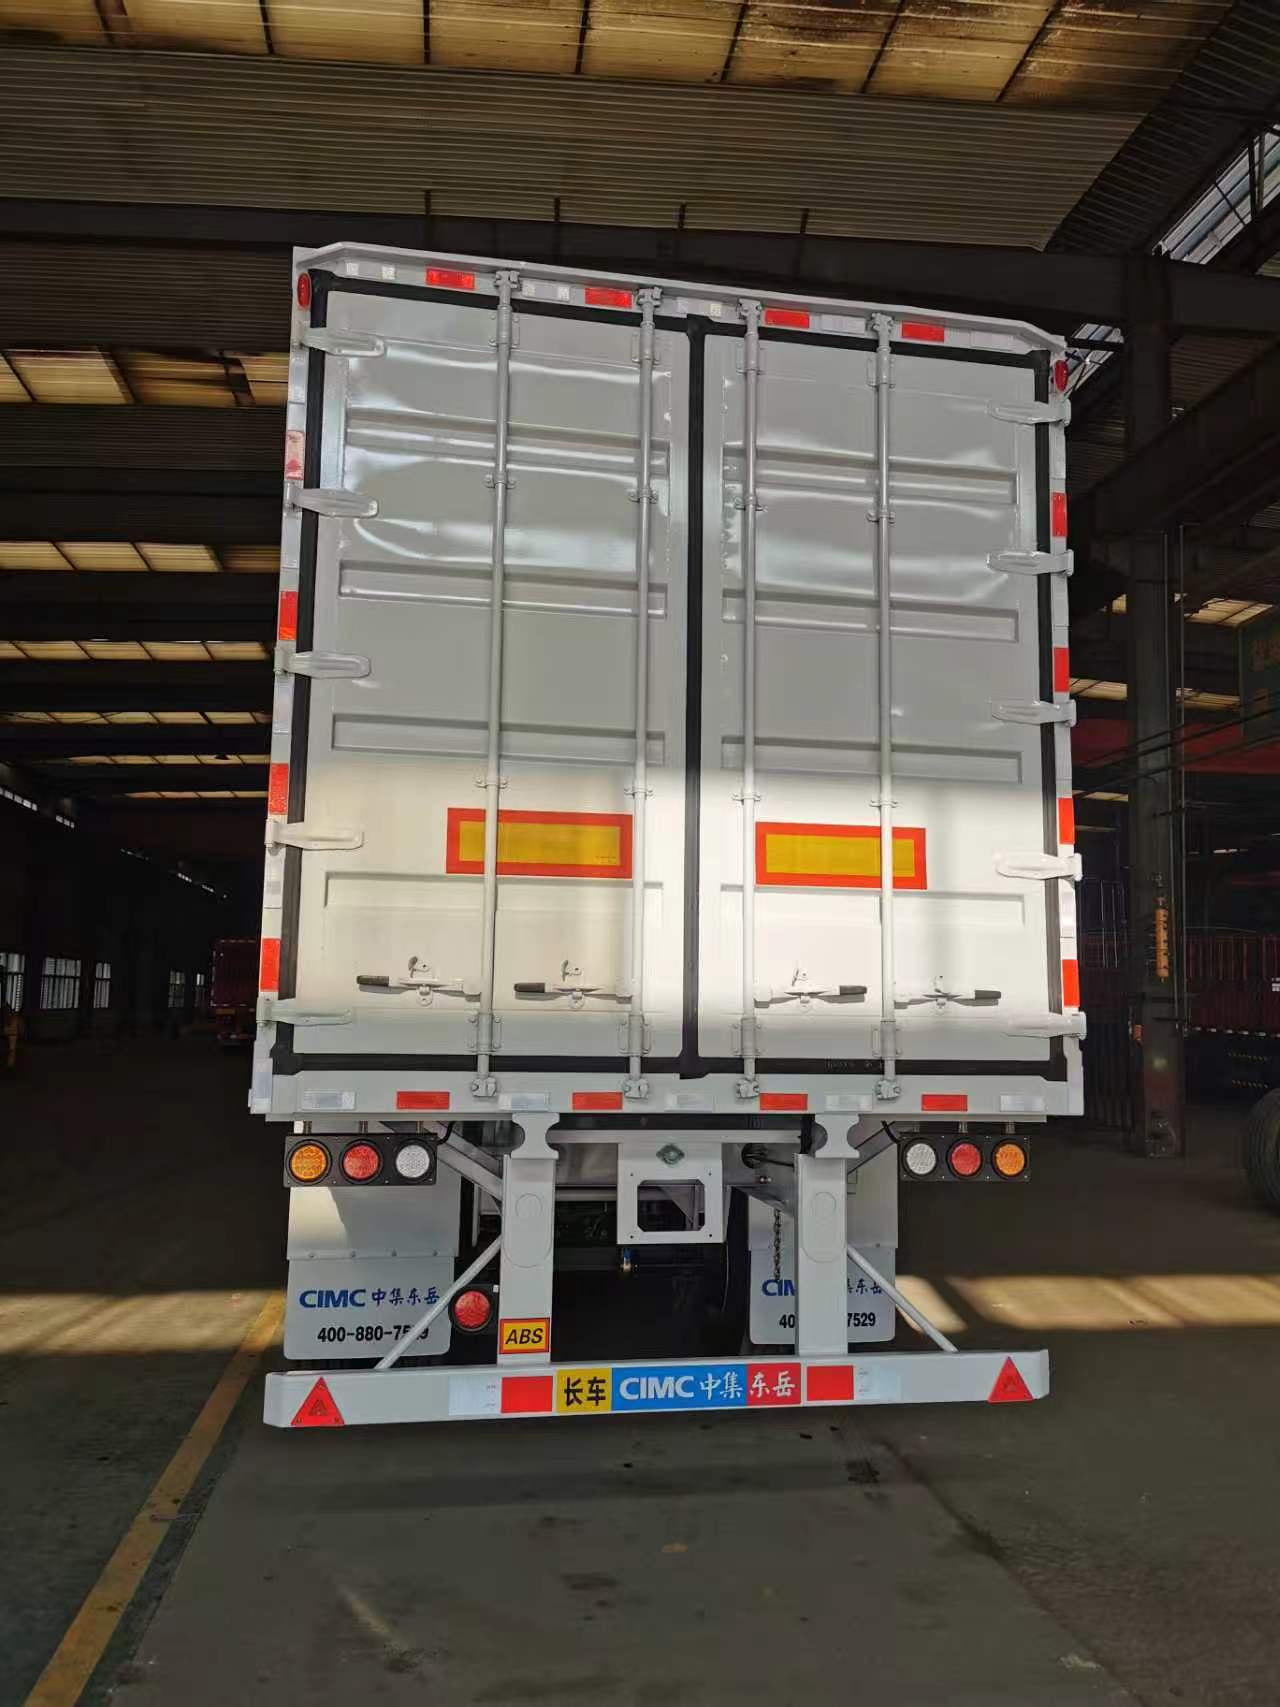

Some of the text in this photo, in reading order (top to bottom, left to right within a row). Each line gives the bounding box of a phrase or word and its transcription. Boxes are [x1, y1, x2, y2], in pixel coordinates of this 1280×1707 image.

[299, 1287, 440, 1308] CIMC 中集东岳
[505, 1328, 543, 1345] ABS
[564, 1376, 606, 1407] 长车
[619, 1375, 694, 1400] CIMC
